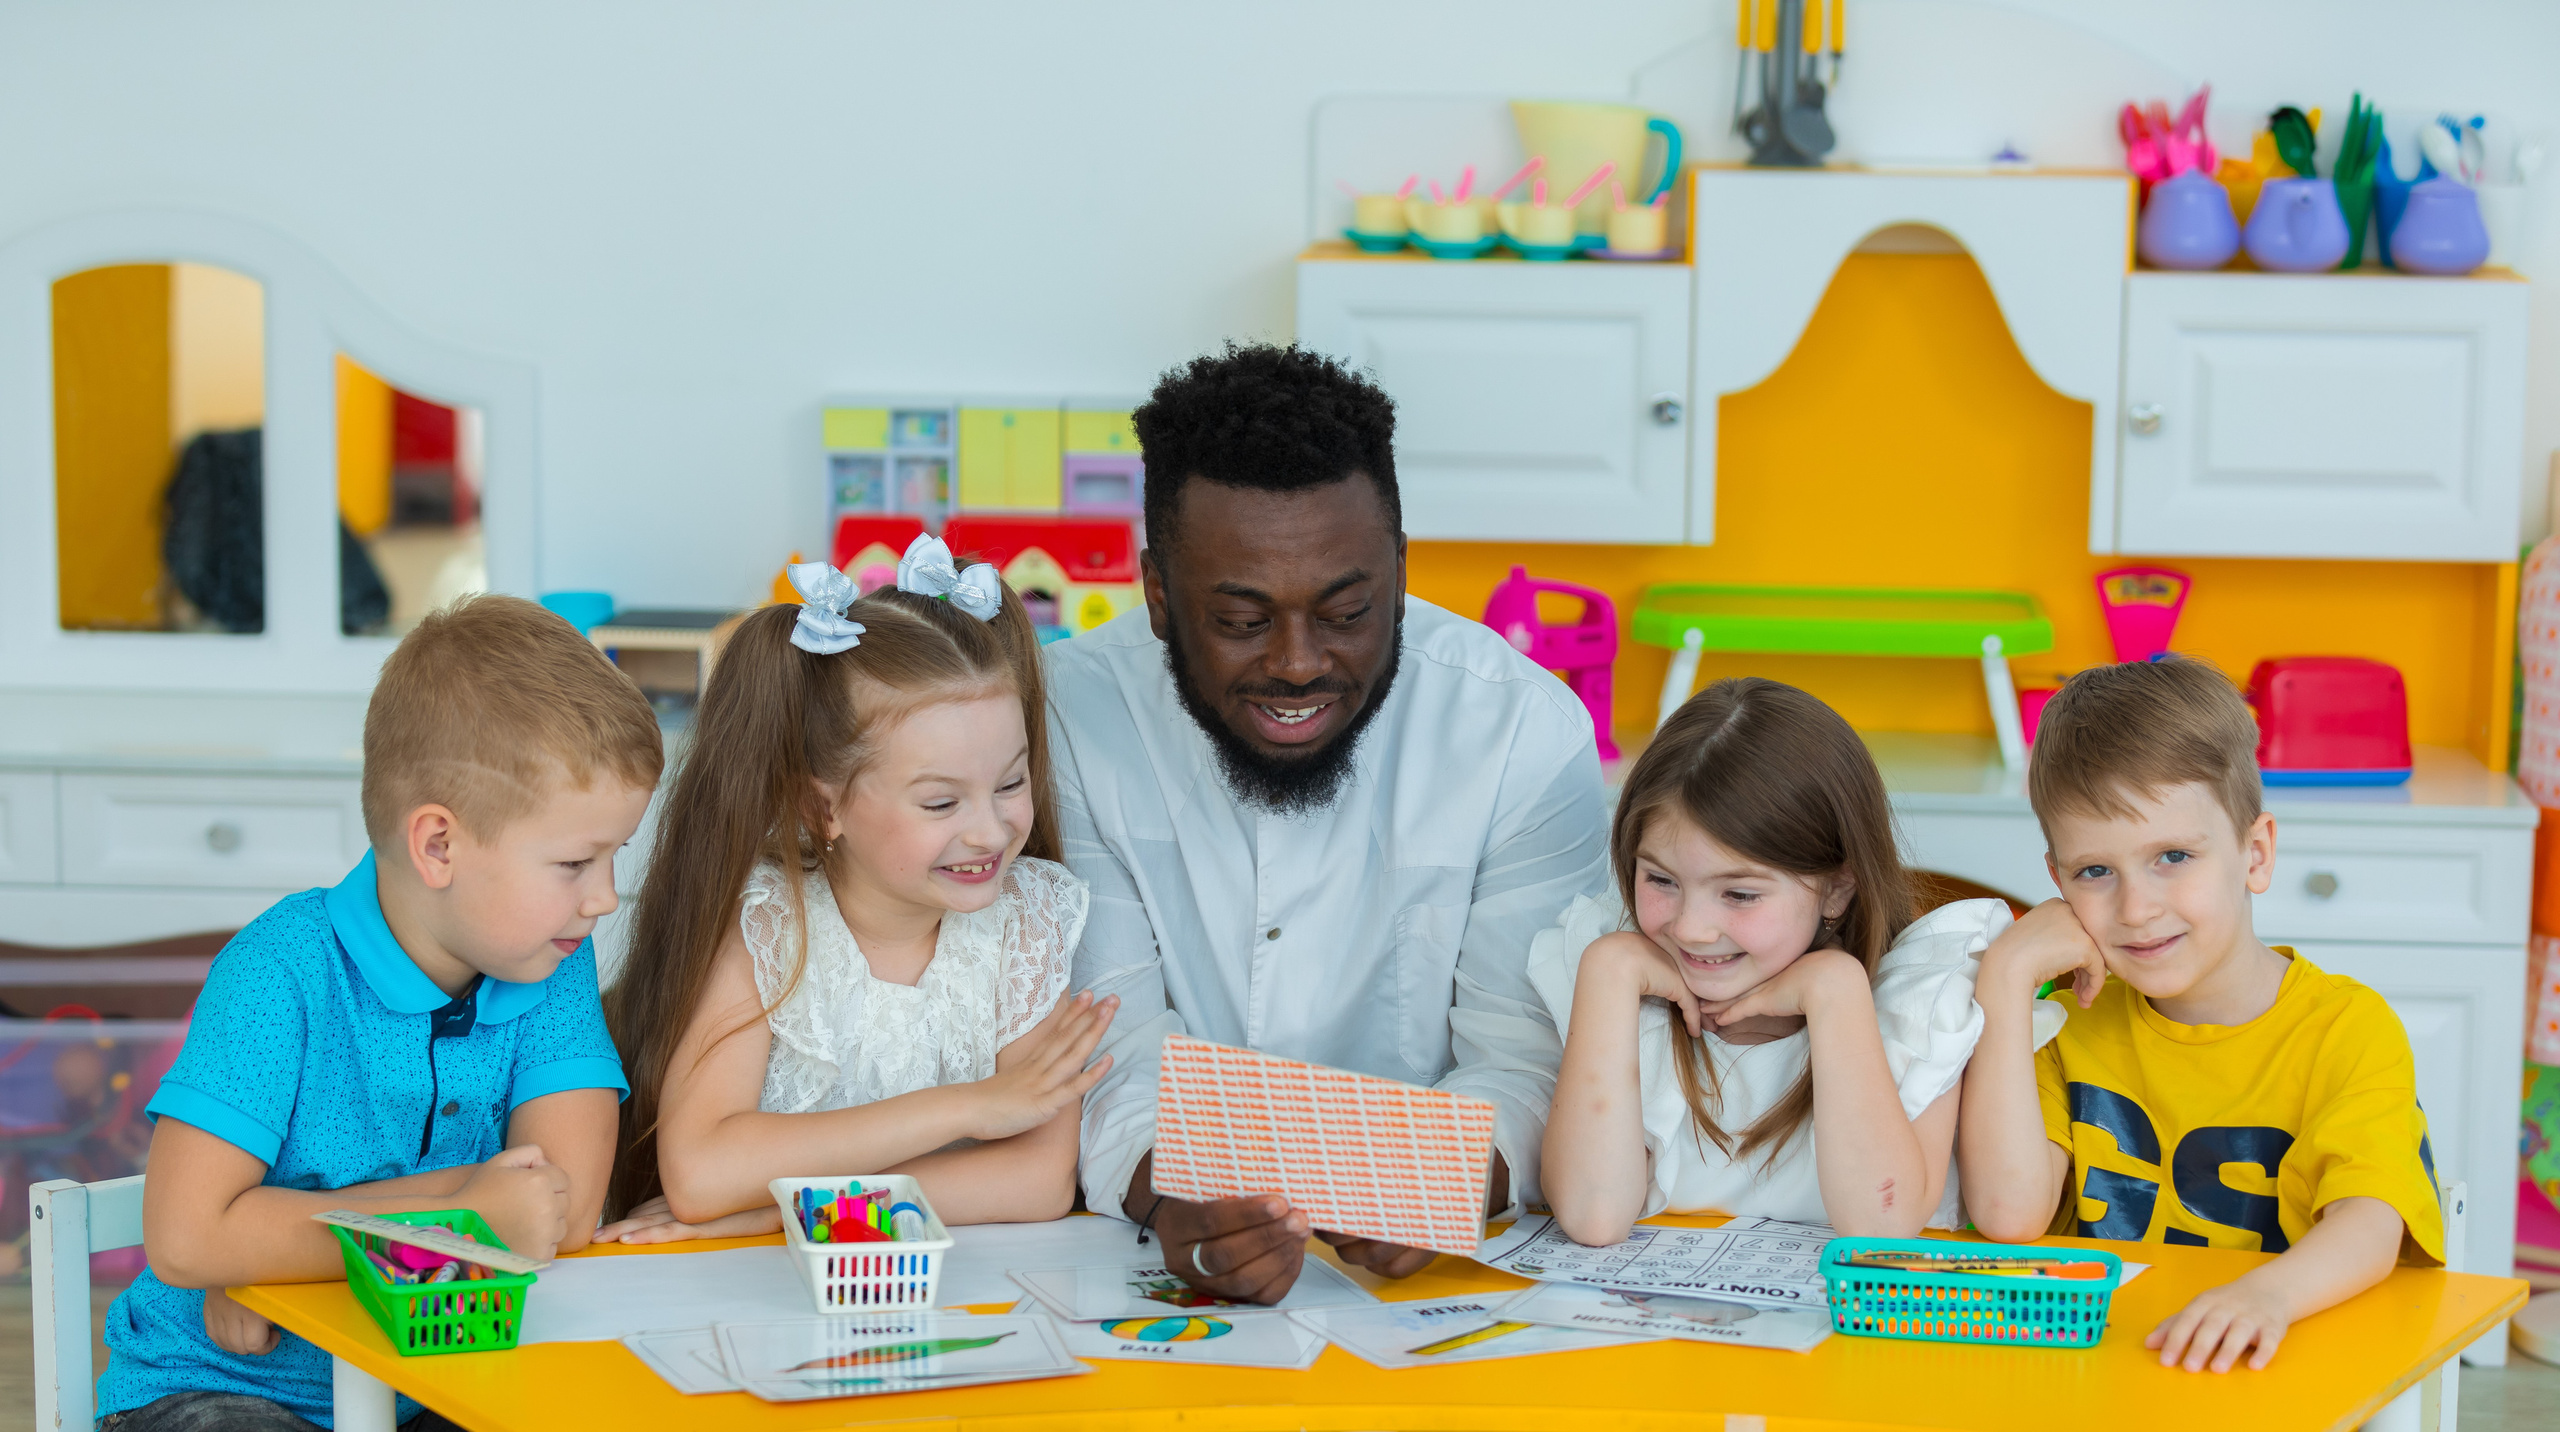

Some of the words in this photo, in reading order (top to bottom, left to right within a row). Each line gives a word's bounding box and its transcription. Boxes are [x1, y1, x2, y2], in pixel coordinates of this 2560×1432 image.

[491, 1093, 508, 1118] BOS
[1572, 1275, 1652, 1286] COLOR
[1711, 1281, 1801, 1299] COUNT
[1412, 1303, 1486, 1316] RULER
[852, 1325, 914, 1335] CORN
[1572, 1312, 1746, 1337] HIPPOPOTAMUS
[1119, 1343, 1173, 1354] BALL
